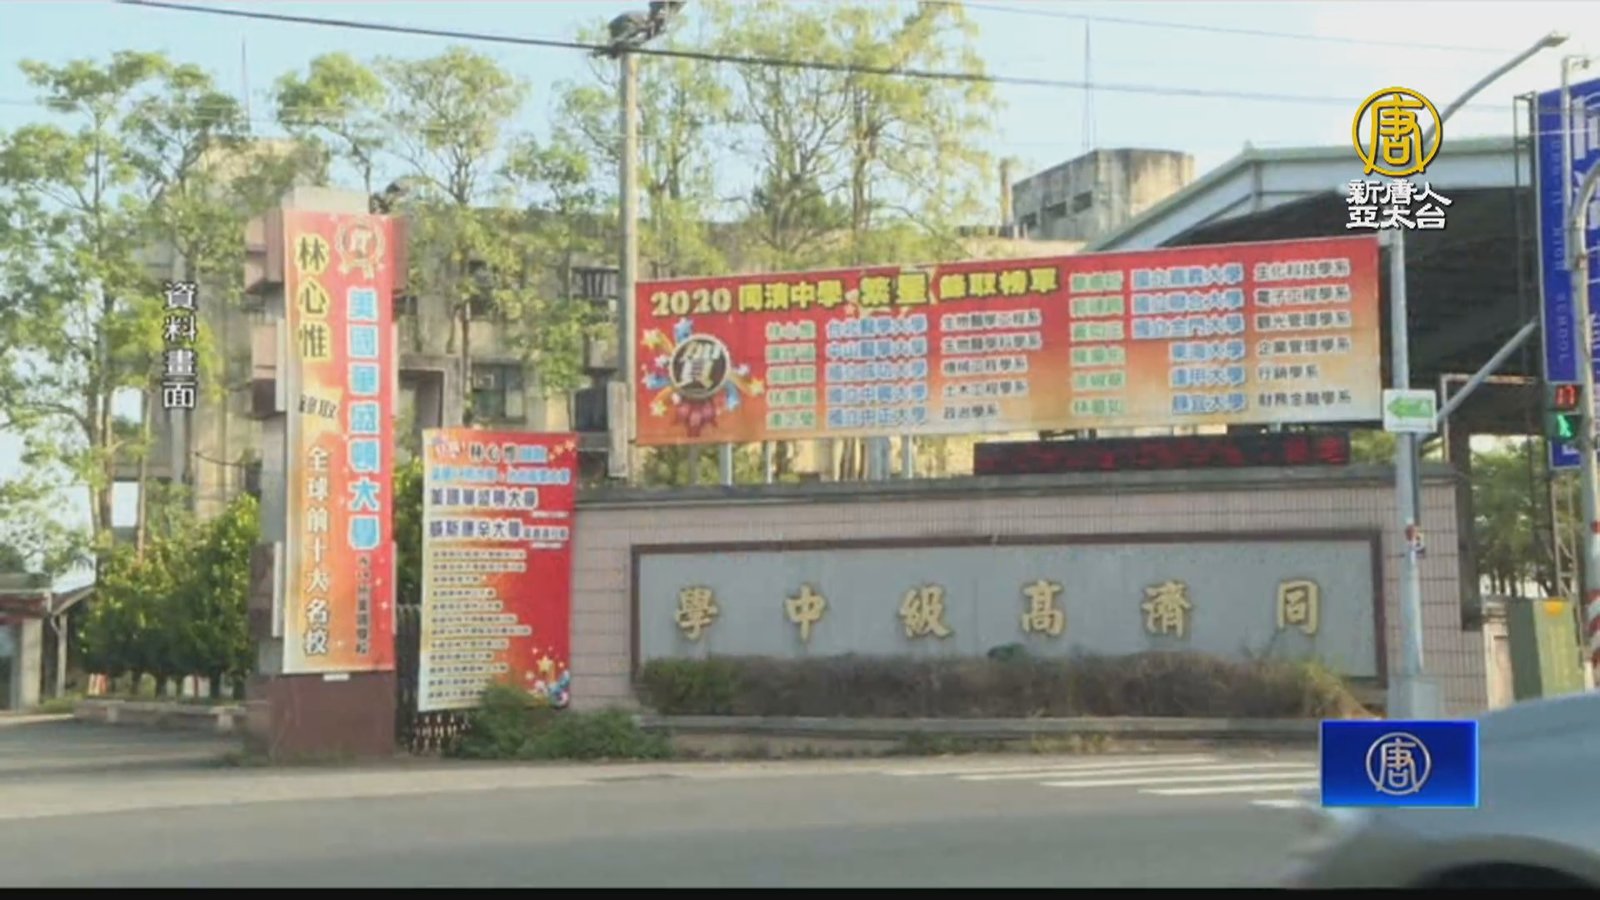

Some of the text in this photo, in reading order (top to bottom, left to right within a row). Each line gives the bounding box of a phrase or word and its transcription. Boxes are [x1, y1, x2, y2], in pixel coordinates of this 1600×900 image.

[297, 234, 330, 361] 林心惟
[651, 288, 731, 316] 2020
[346, 286, 381, 549] 美國華盛頓大學
[303, 446, 330, 655] 全球前十大名校
